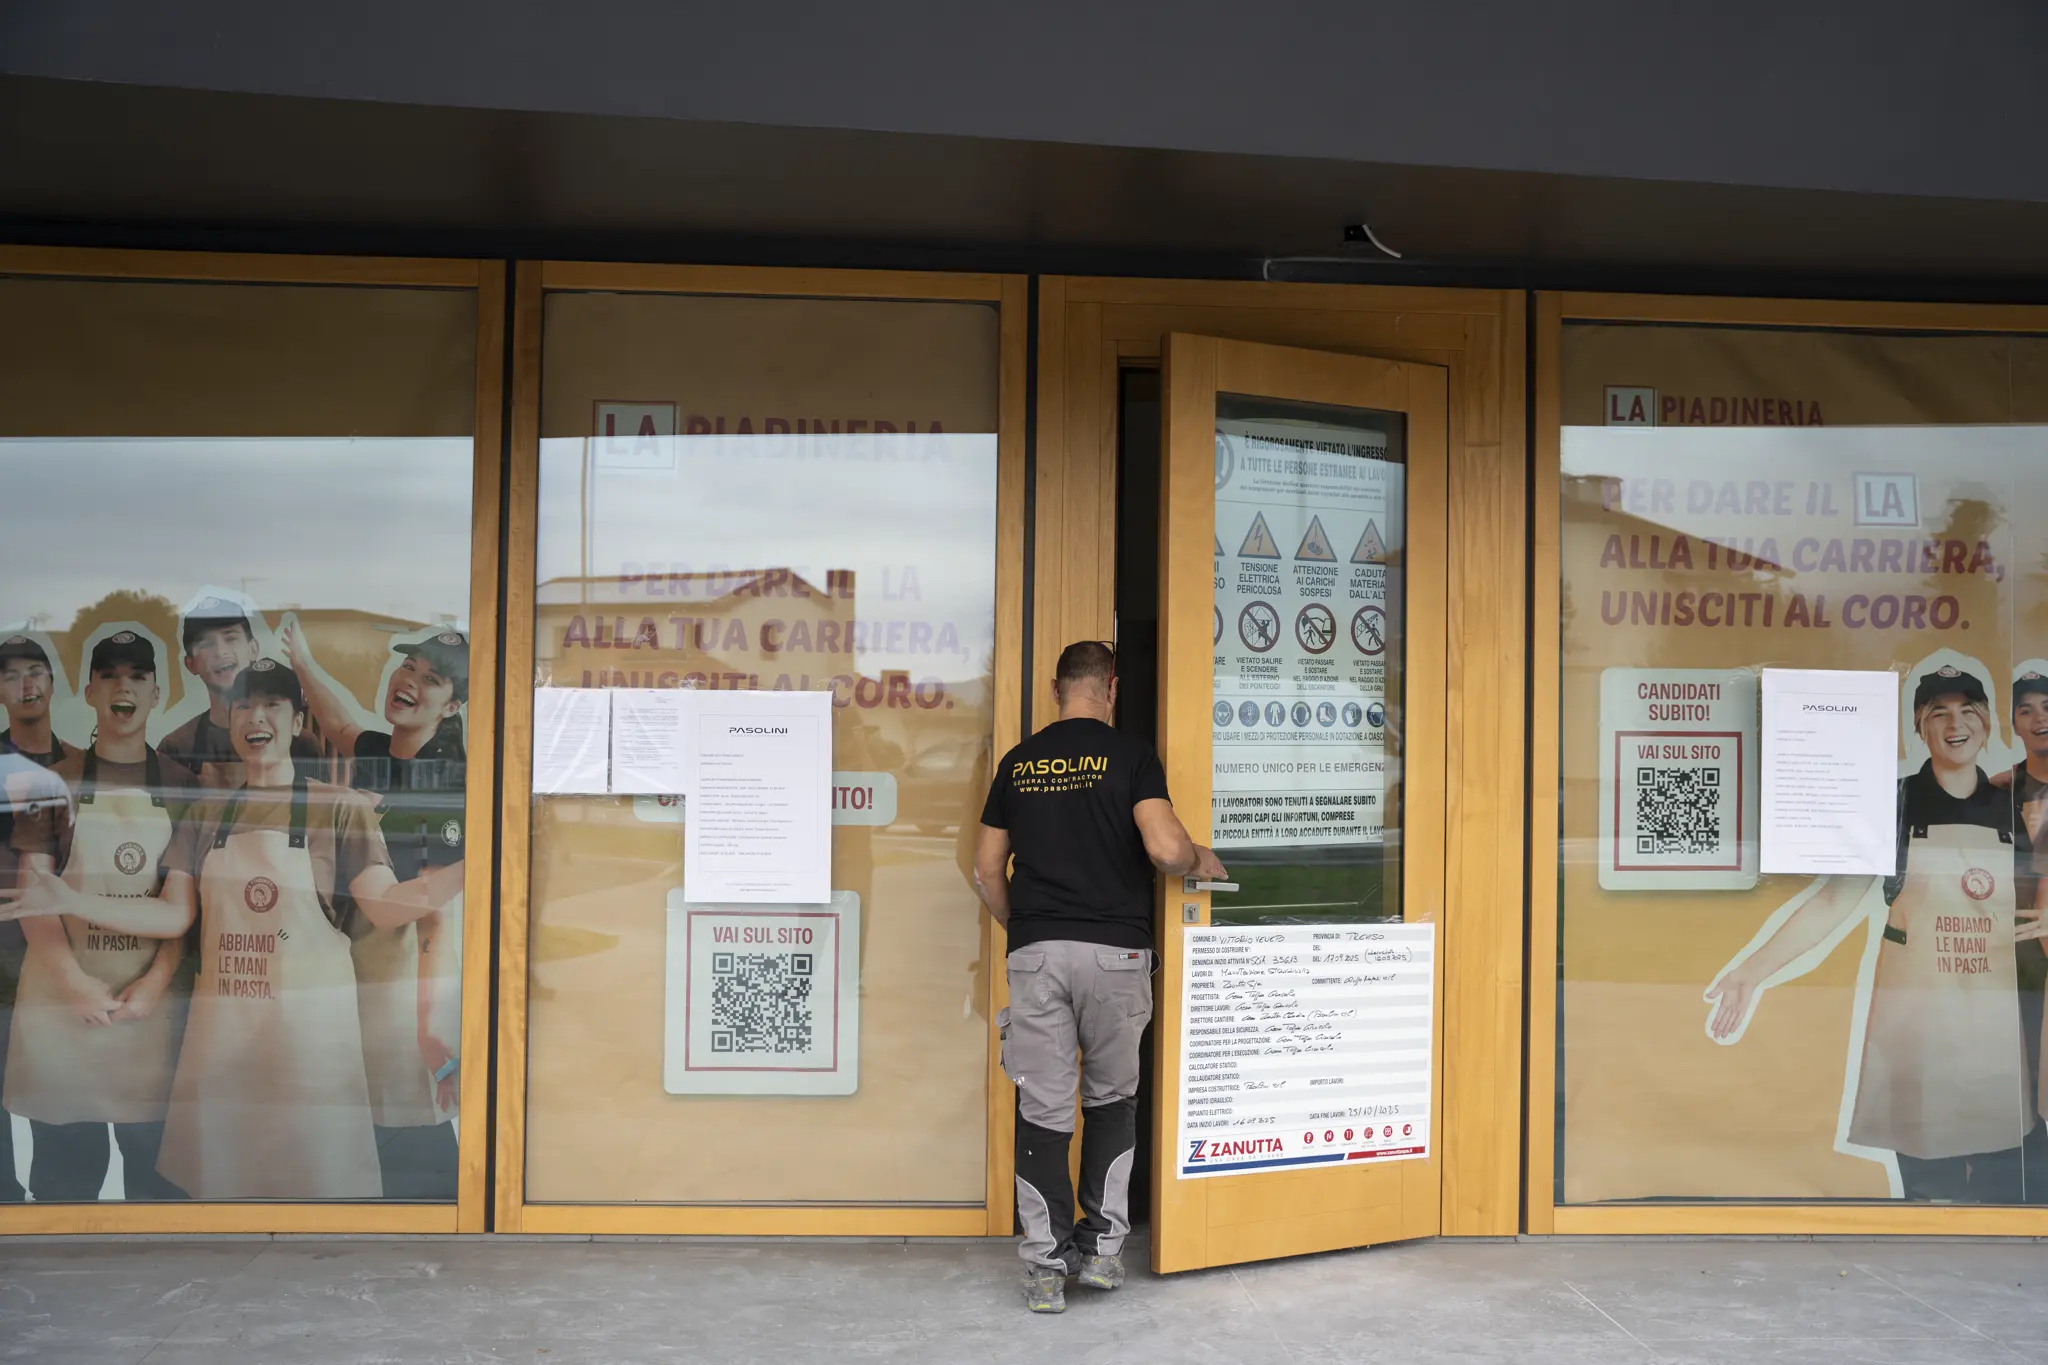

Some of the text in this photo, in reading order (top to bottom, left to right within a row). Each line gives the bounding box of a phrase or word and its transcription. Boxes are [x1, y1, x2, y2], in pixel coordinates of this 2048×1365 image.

[1611, 394, 1824, 427] LA PIADINERIA
[605, 414, 953, 462] LA PIADINERIA
[1252, 435, 1314, 454] RIGOROSAMENTE
[1316, 441, 1346, 456] VIETATO
[1247, 457, 1272, 472] TUTTE
[1273, 459, 1283, 473] LE
[1284, 460, 1318, 476] PERSONE
[1320, 463, 1358, 479] ESTRANEE
[1359, 466, 1366, 480] AI
[1602, 478, 1906, 518] PER DARE IL LA
[1600, 534, 2006, 582] ALLA TUA CARRIERA,
[1241, 562, 1278, 573] TENSIONE
[1293, 566, 1338, 576] ATTENZIONE
[619, 561, 921, 600] PER DARE IL LA
[1239, 574, 1280, 584] ELETTRICA
[1296, 577, 1335, 586] AI CARICHI
[1237, 585, 1282, 596] PERICOLOSA
[1300, 587, 1331, 597] SOSPESI
[1601, 590, 1971, 630] UNISCITI AL CORO.
[562, 615, 970, 663] ALLA TUA CARRIERA,
[1261, 657, 1283, 665] SALIRE
[1297, 658, 1316, 666] VIETATO
[830, 675, 954, 709] CORO.
[1637, 682, 1721, 701] CANDIDATI
[1648, 704, 1711, 722] SUBITO!
[1637, 745, 1721, 760] VAI SUL SITO
[1012, 756, 1108, 778] PASOLINI
[1215, 763, 1259, 774] NUMERO
[1262, 763, 1294, 773] UNICO
[1297, 763, 1316, 773] PER
[1319, 763, 1332, 773] LE
[1013, 774, 1103, 786] GENERAL CONTRACTOR
[1019, 781, 1093, 793] www.pasolini.it
[1222, 795, 1377, 808] LAVORATORI SONO TENUTI A SEGNALARE SUBITO
[1220, 811, 1355, 824] AI PROPRI CAPI GLI INFORTUNI, COMPRESE
[1214, 830, 1221, 840] DI
[1222, 829, 1250, 839] PICCOLA
[1251, 826, 1273, 838] ENTITÀ
[1281, 828, 1298, 837] LORO
[1299, 827, 1332, 837] ACCADUTE
[1333, 826, 1361, 836] DURANTE
[1935, 916, 1992, 933] ABBIAMO
[87, 934, 141, 951] IN PASTA.
[218, 933, 276, 953] ABBIAMO
[713, 926, 813, 944] VAI SUL SITO
[1935, 936, 1986, 953] LE MANI
[218, 957, 268, 976] LE MANI
[1937, 956, 1992, 974] IN PASTA.
[218, 979, 276, 1000] IN PASTA.
[1189, 1051, 1222, 1059] COORDINATORE
[1211, 1138, 1283, 1157] ZANUTTA
